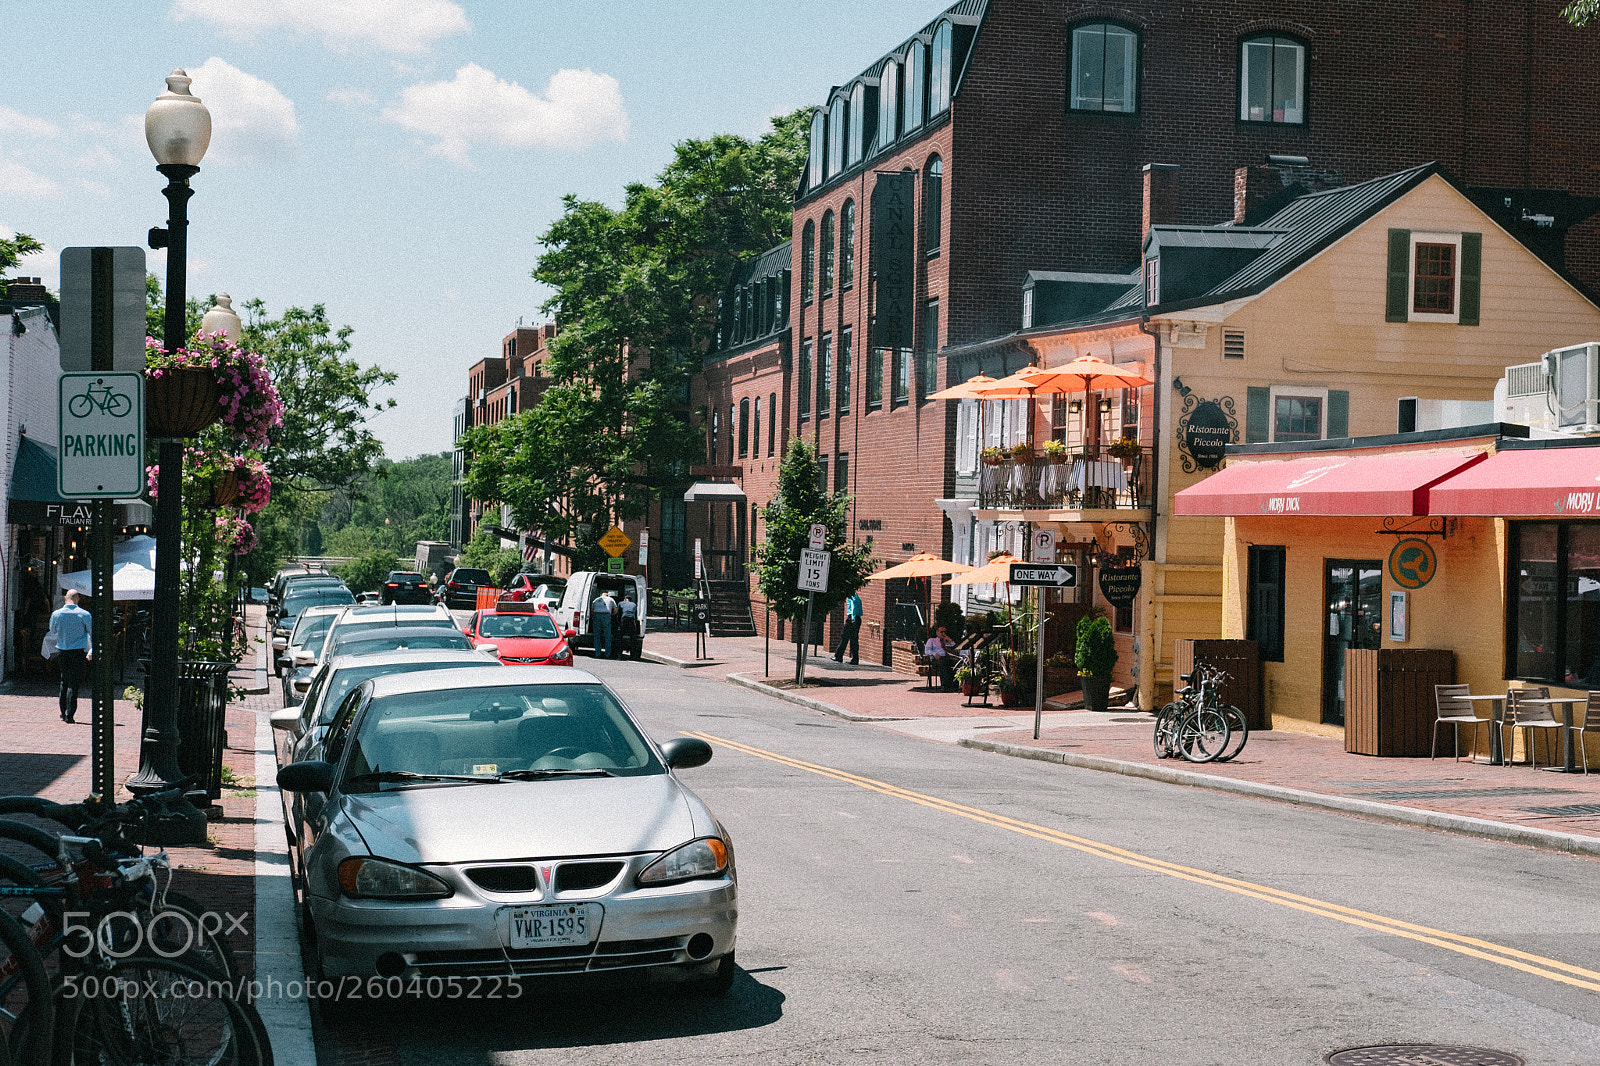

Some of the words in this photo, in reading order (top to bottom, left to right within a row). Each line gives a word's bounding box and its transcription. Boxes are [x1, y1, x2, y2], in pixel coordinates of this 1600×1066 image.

[887, 177, 905, 250] CANAL
[886, 258, 905, 343] SQUARE
[1188, 424, 1229, 434] Ristorante
[64, 433, 136, 456] PARKING
[1193, 437, 1223, 447] Piccolo
[1269, 497, 1285, 513] MOBY
[1285, 497, 1300, 511] DICK
[1566, 492, 1595, 513] MOBY
[60, 517, 85, 525] ITALIAN
[804, 551, 827, 560] WEIGHT
[807, 569, 820, 580] 15
[1016, 570, 1034, 580] ONE
[1038, 570, 1057, 580] WAY
[1102, 573, 1139, 581] Ristorante
[806, 580, 820, 588] TONS
[1108, 584, 1135, 593] Piccolo
[530, 909, 569, 918] VIRGINIA
[515, 916, 585, 938] VMR-1595
